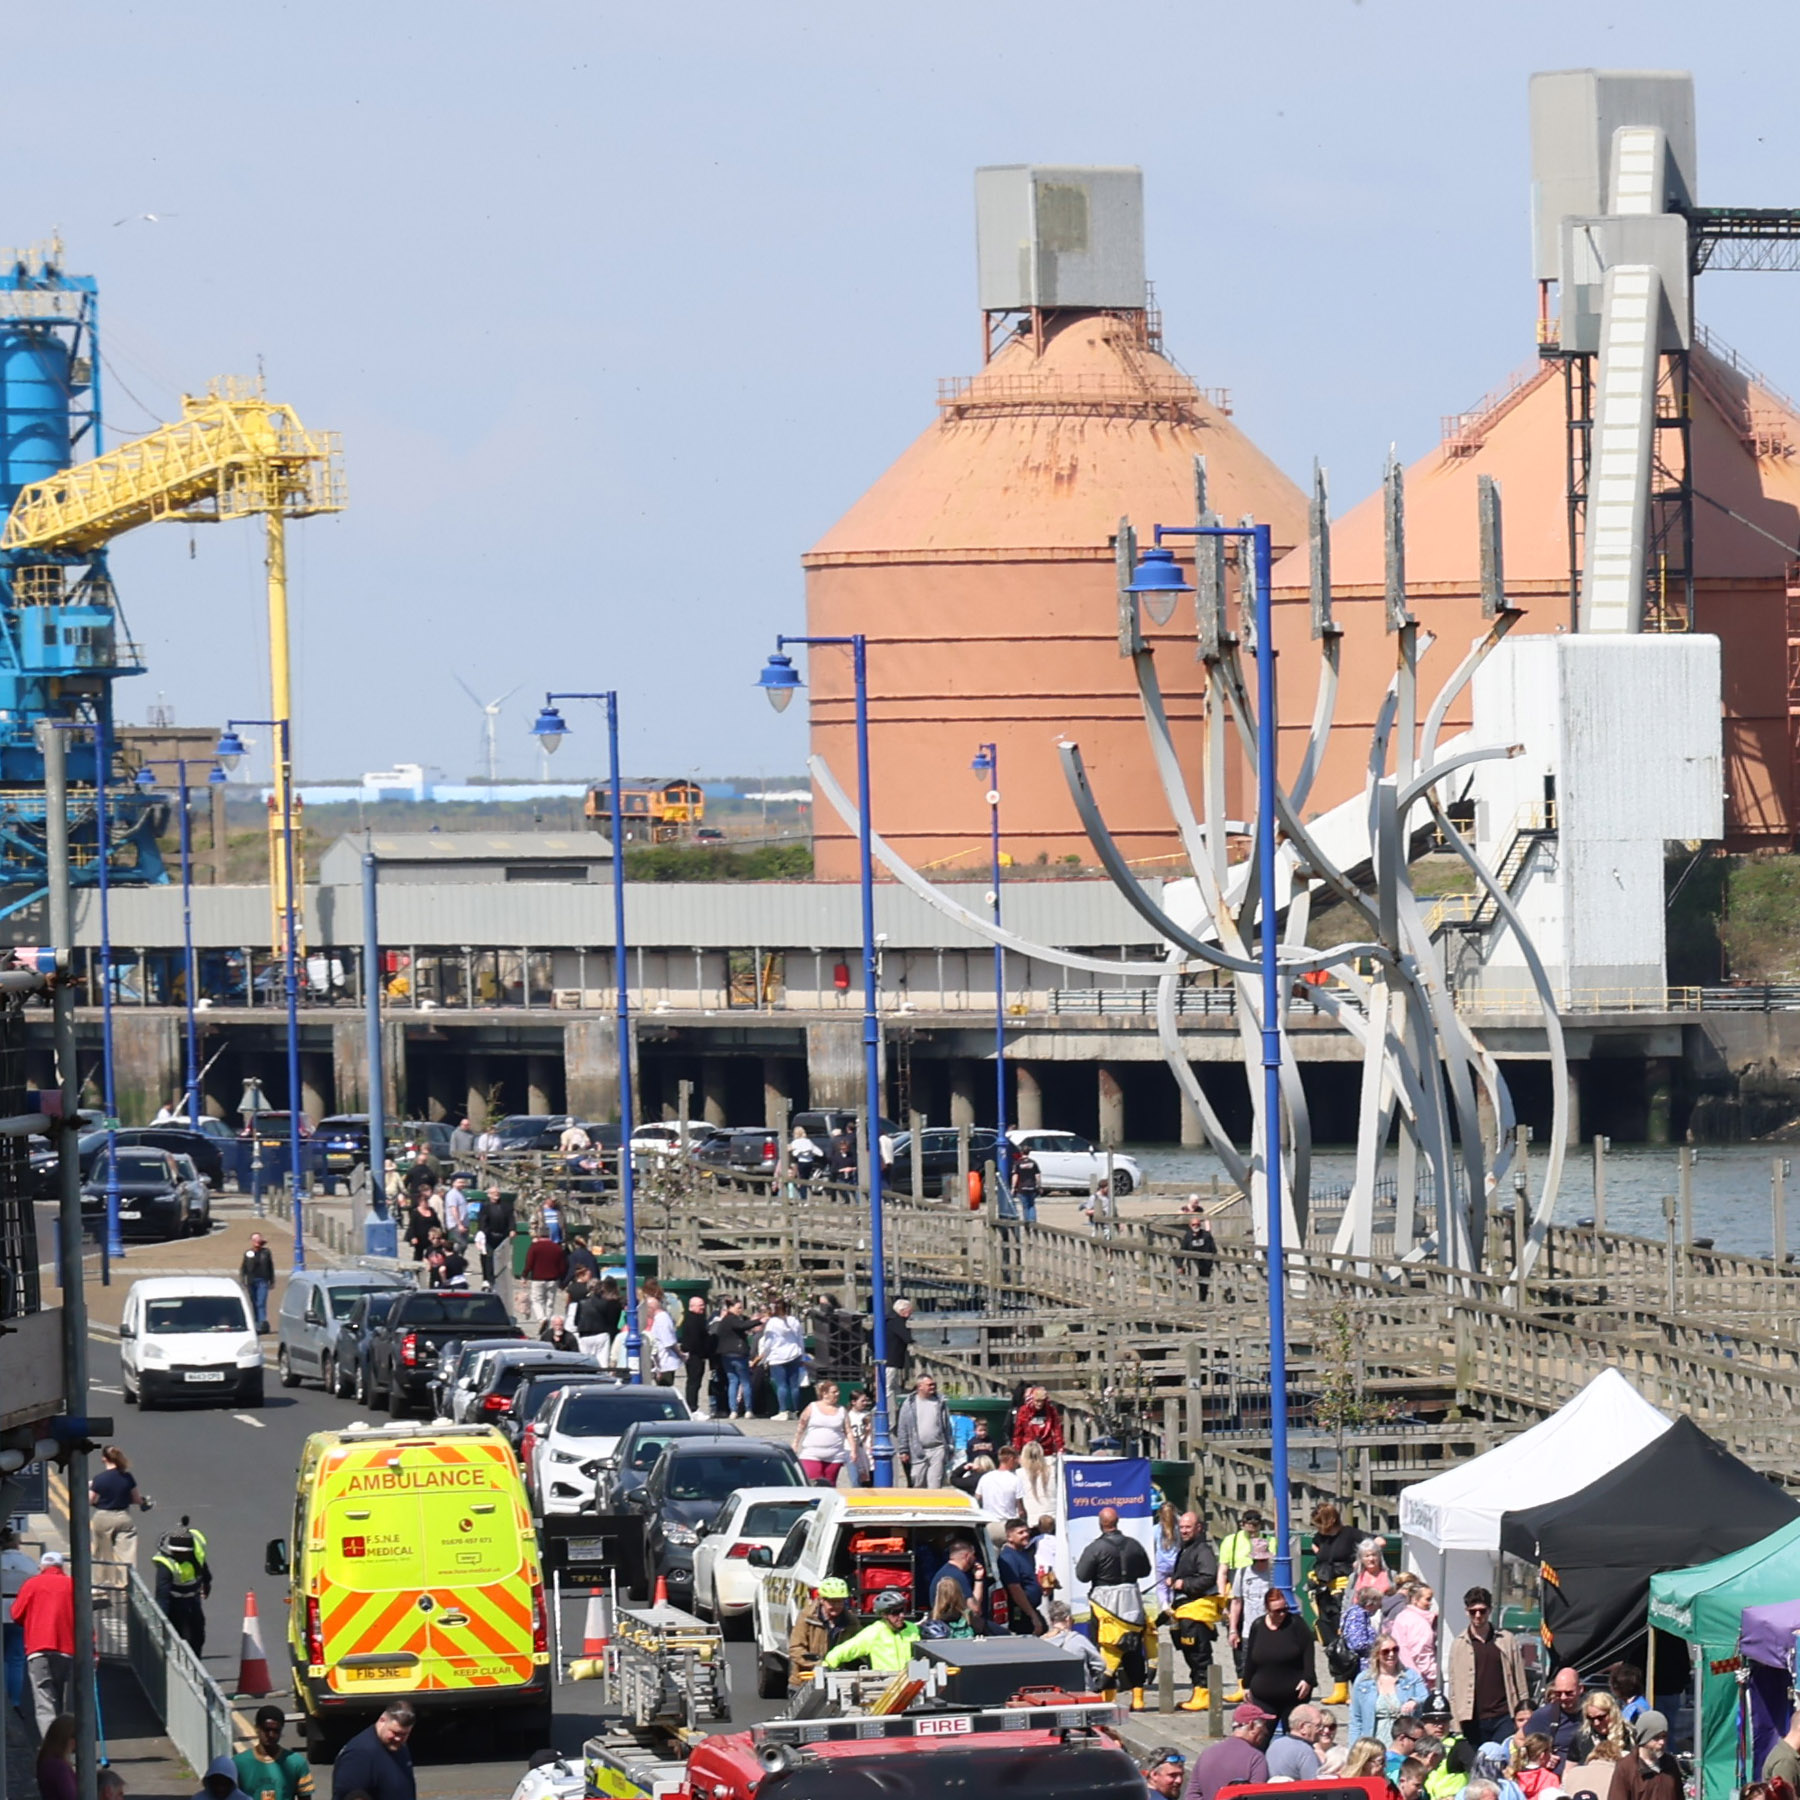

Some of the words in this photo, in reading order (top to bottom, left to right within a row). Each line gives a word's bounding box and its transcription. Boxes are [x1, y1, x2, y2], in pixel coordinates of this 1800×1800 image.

[348, 1469, 485, 1492] AMBULANCE
[1073, 1497, 1089, 1507] 999
[1091, 1494, 1145, 1507] Coastguard
[366, 1534, 400, 1544] F.S.N.E
[366, 1547, 413, 1556] MEDICAL
[356, 1668, 375, 1678] F16
[378, 1667, 400, 1678] SNE
[453, 1668, 477, 1676] KEEP
[480, 1666, 511, 1675] CLEAR
[920, 1719, 967, 1734] FIRE
